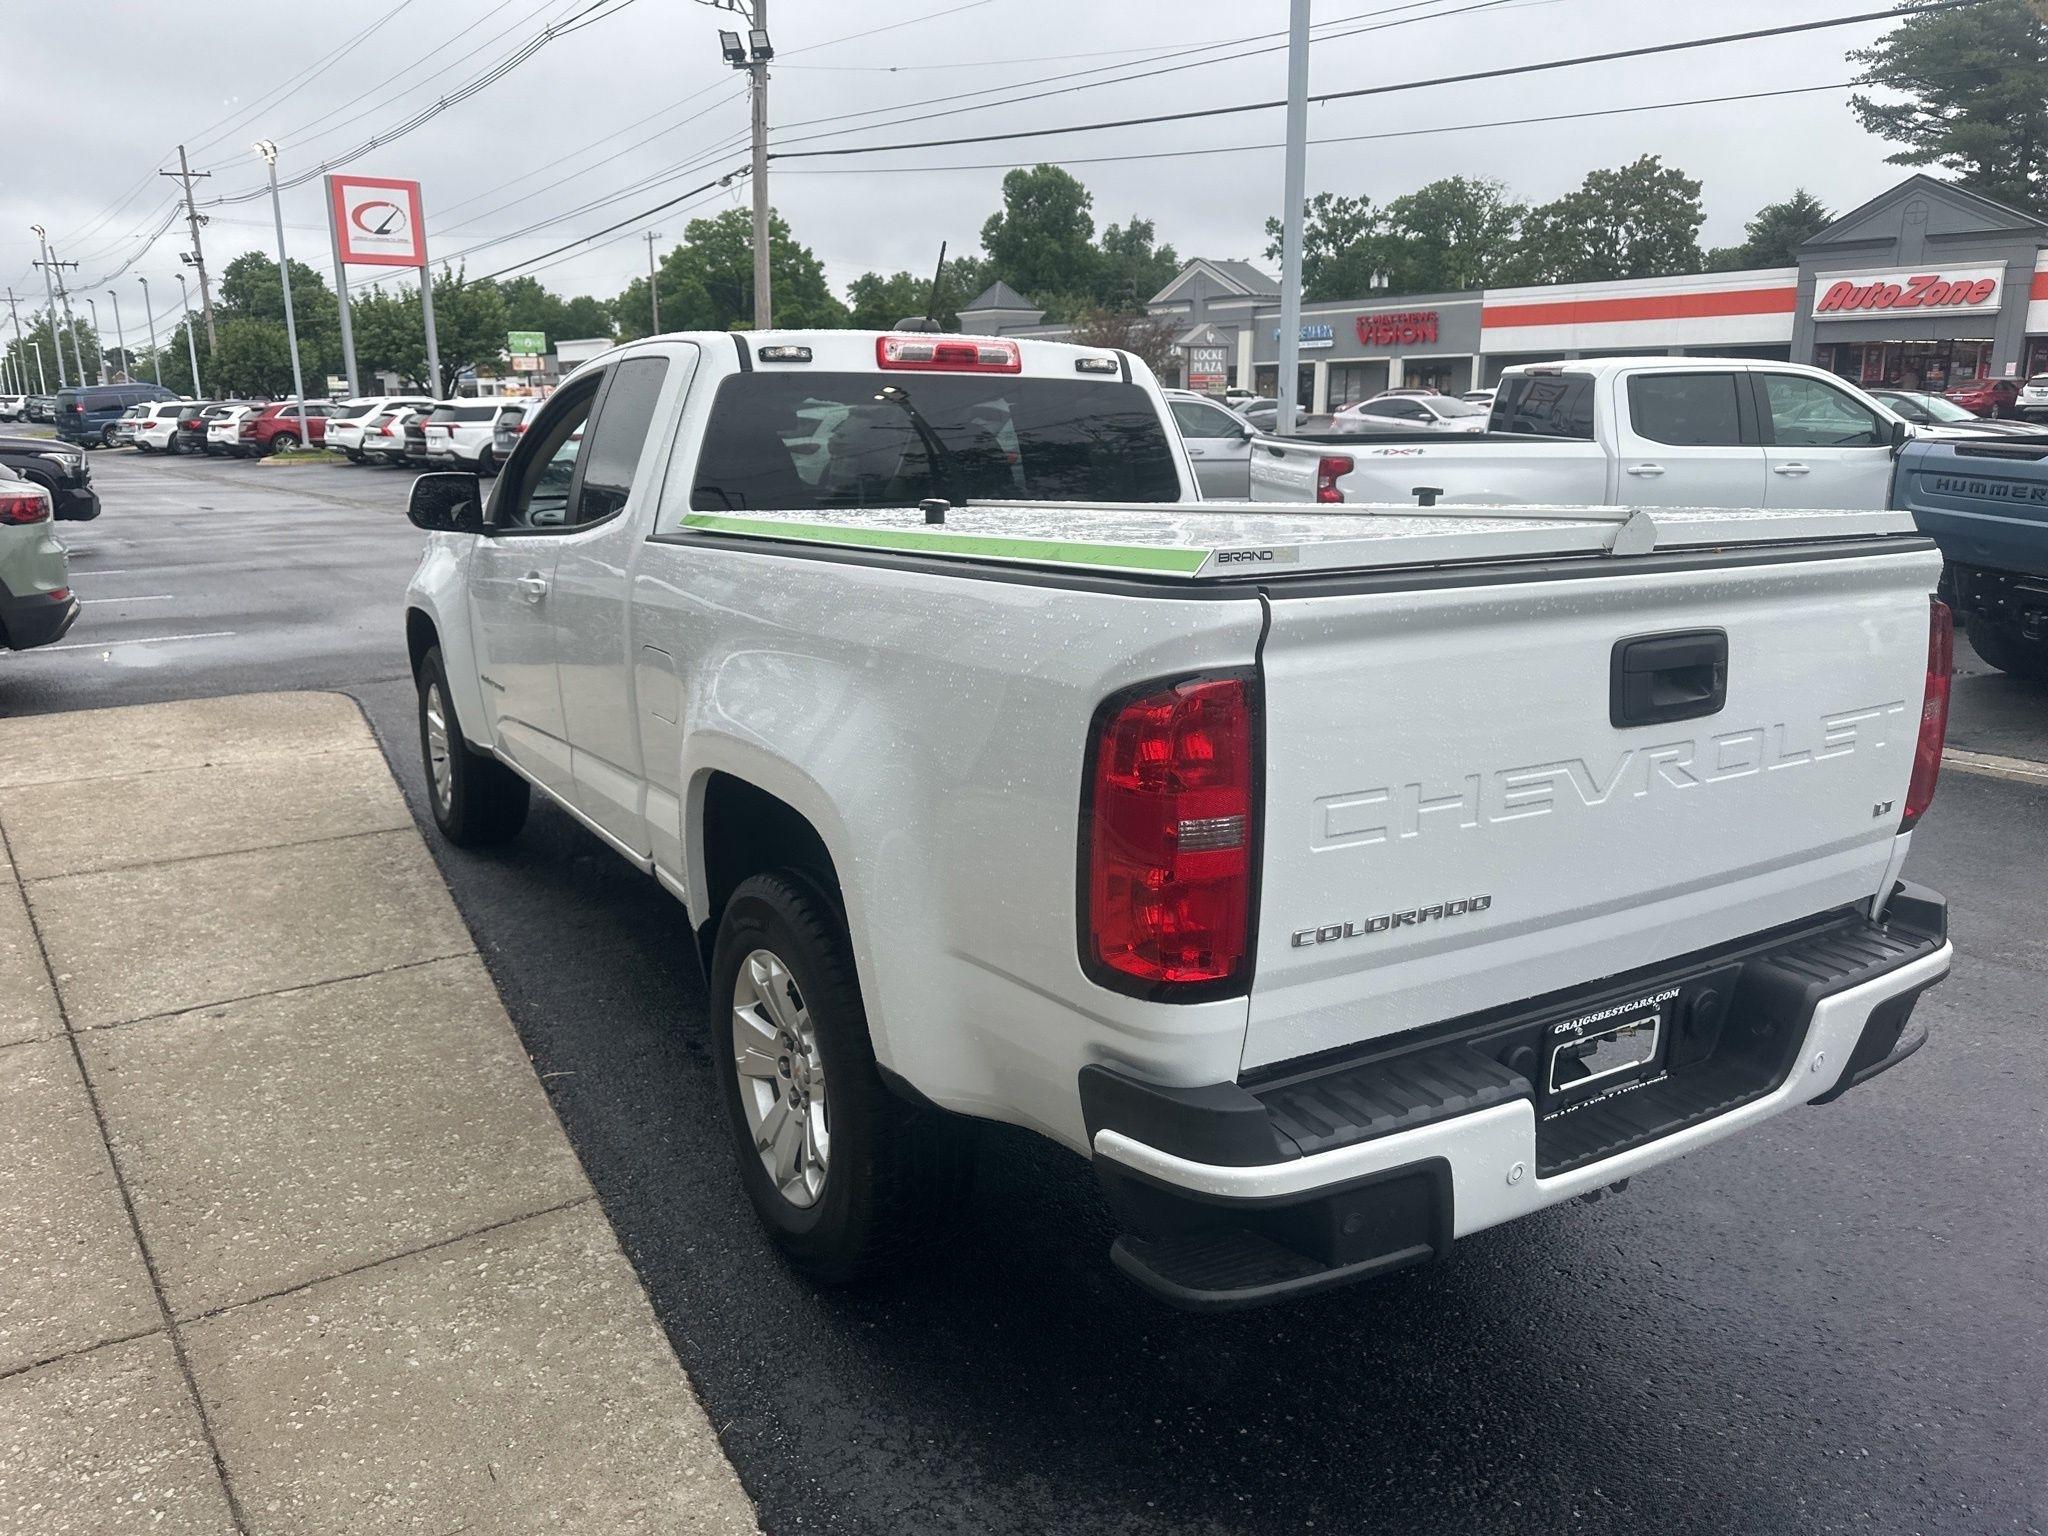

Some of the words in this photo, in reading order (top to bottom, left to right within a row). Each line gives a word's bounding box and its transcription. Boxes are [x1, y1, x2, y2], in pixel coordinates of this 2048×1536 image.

[1816, 275, 1996, 311] AutoZone
[1356, 321, 1439, 346] VISION
[1193, 361, 1222, 372] PLAZA
[1194, 349, 1223, 360] LOCKE
[1935, 478, 2048, 501] HUMMER
[1218, 550, 1273, 563] BRAND
[1309, 700, 1905, 853] CHEVROLET
[1873, 800, 1895, 817] LT
[1291, 893, 1492, 948] COLORADO
[1554, 988, 1681, 1034] CRAIGSBESTCARS.COM
